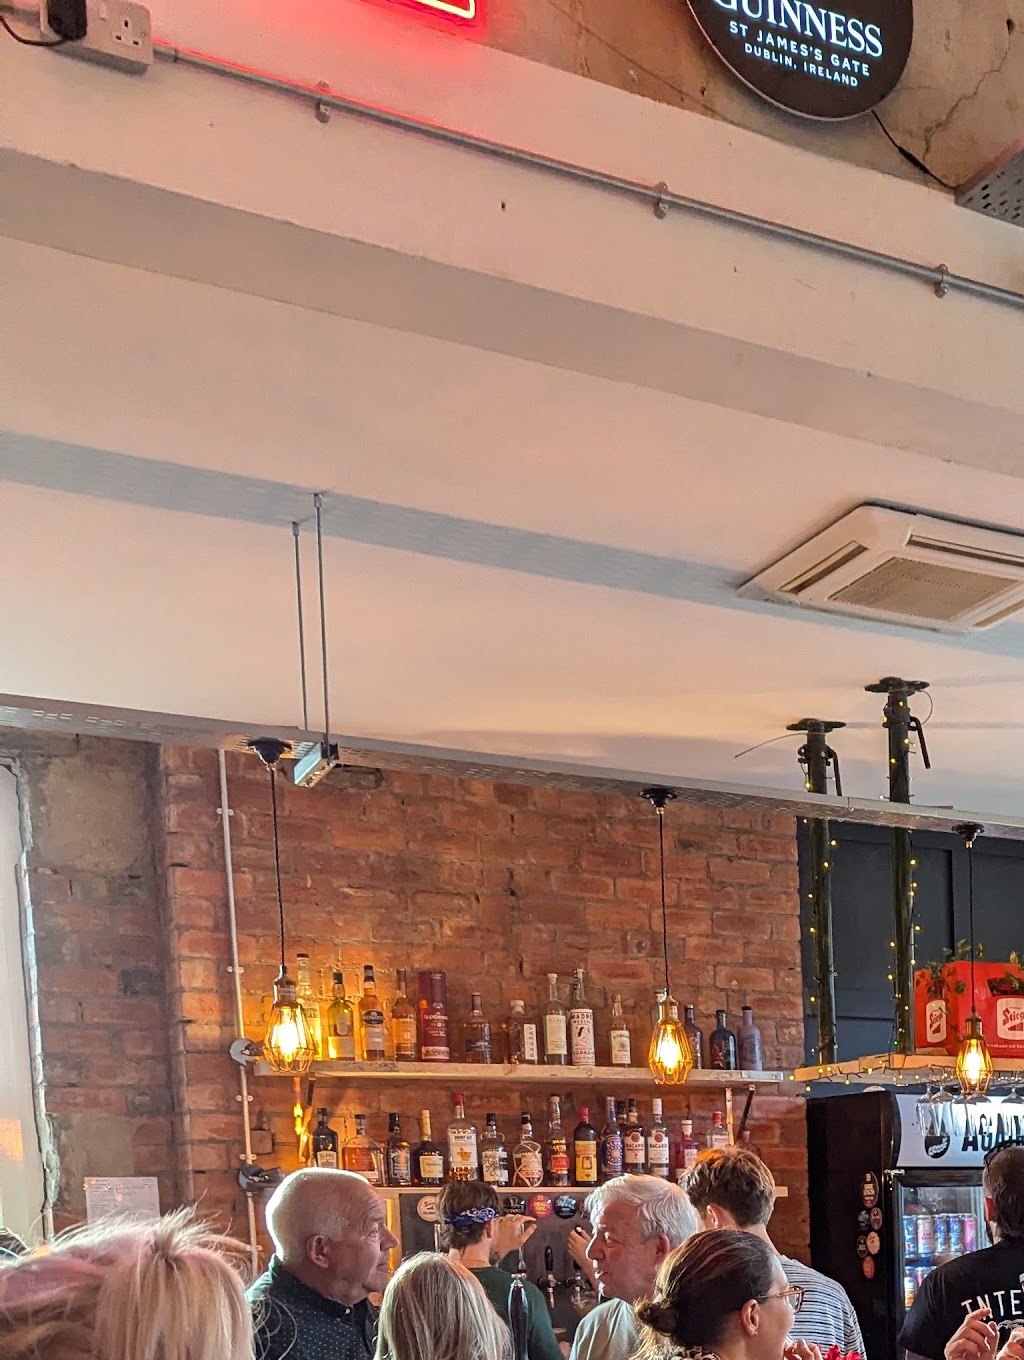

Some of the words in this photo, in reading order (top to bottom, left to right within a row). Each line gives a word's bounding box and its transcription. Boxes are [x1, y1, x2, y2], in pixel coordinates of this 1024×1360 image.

[729, 21, 749, 37] ST
[756, 30, 823, 61] JAMES'S
[830, 54, 870, 76] GATE
[744, 43, 798, 70] DUBLIN,
[803, 61, 859, 87] IRELAND
[961, 1289, 1023, 1320] INTE
